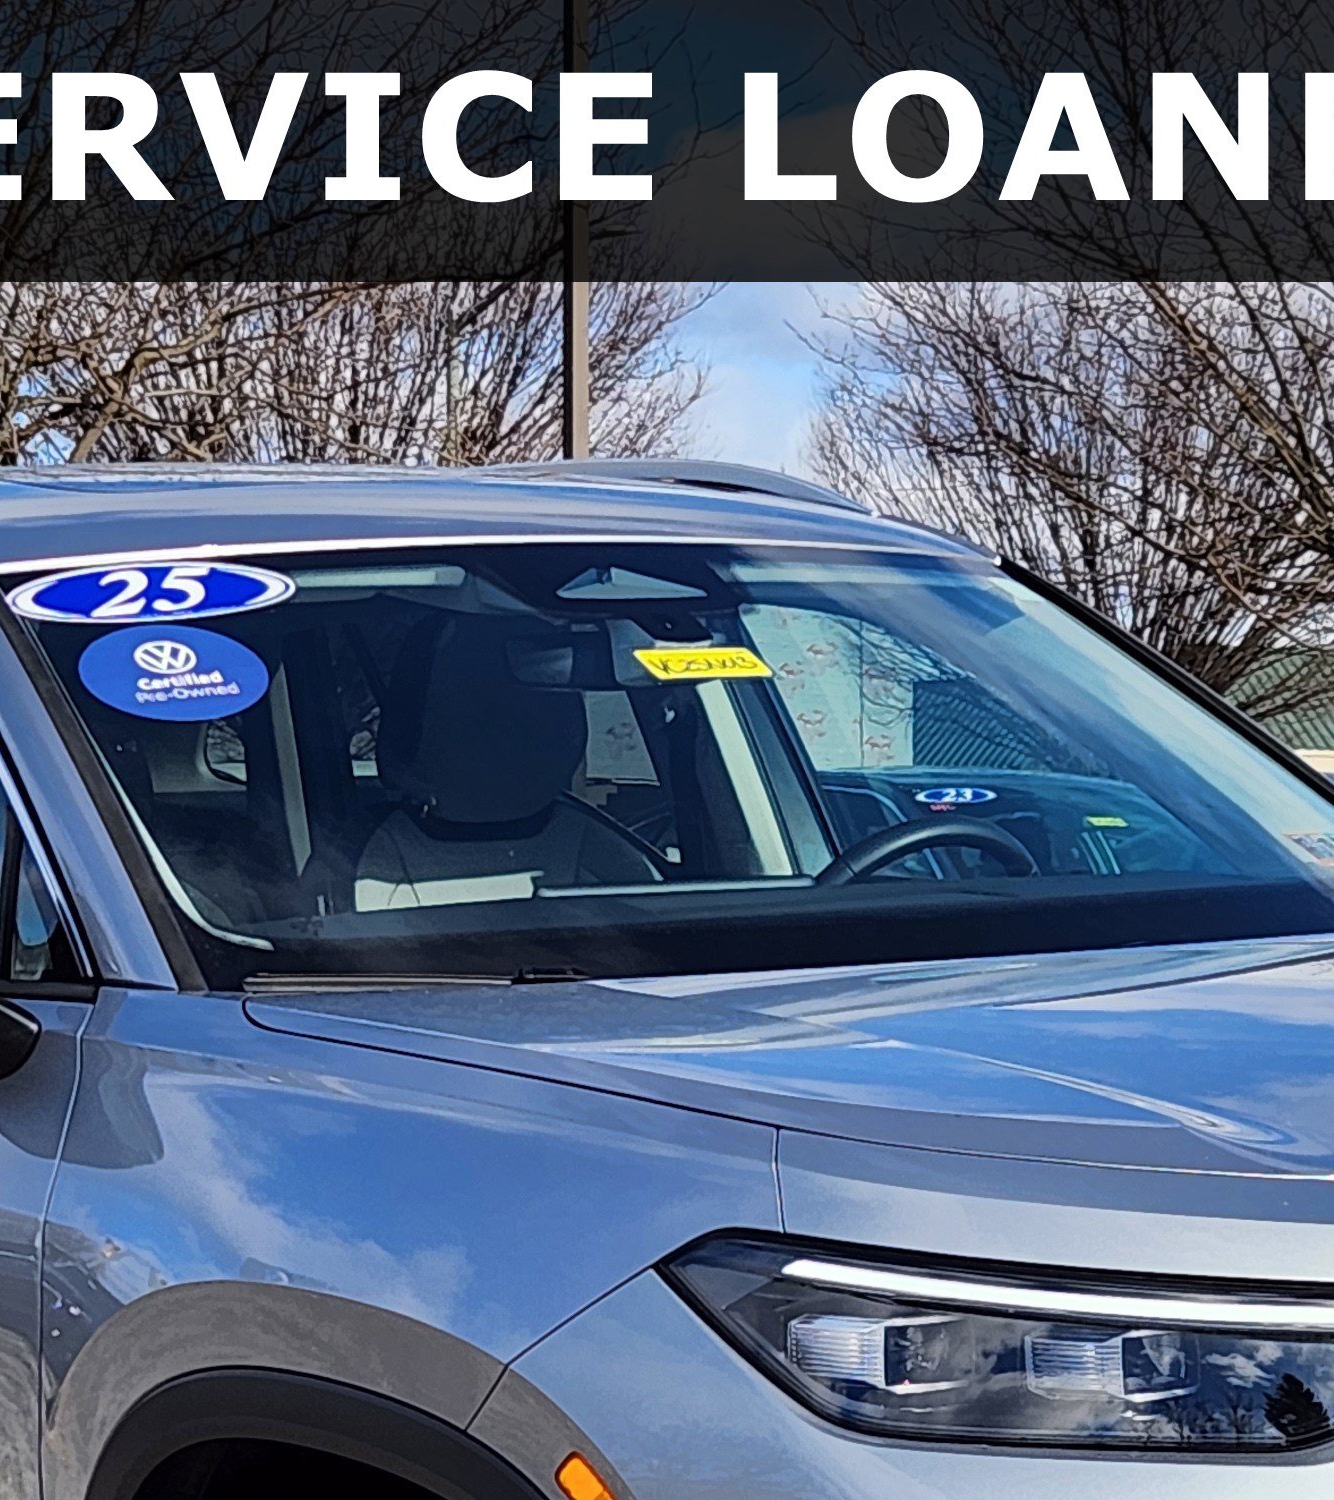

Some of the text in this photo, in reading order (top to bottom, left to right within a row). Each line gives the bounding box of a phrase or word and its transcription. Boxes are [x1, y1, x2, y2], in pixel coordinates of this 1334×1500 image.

[90, 566, 210, 618] 25
[137, 670, 224, 690] Certified
[135, 681, 241, 703] Pre-Owned
